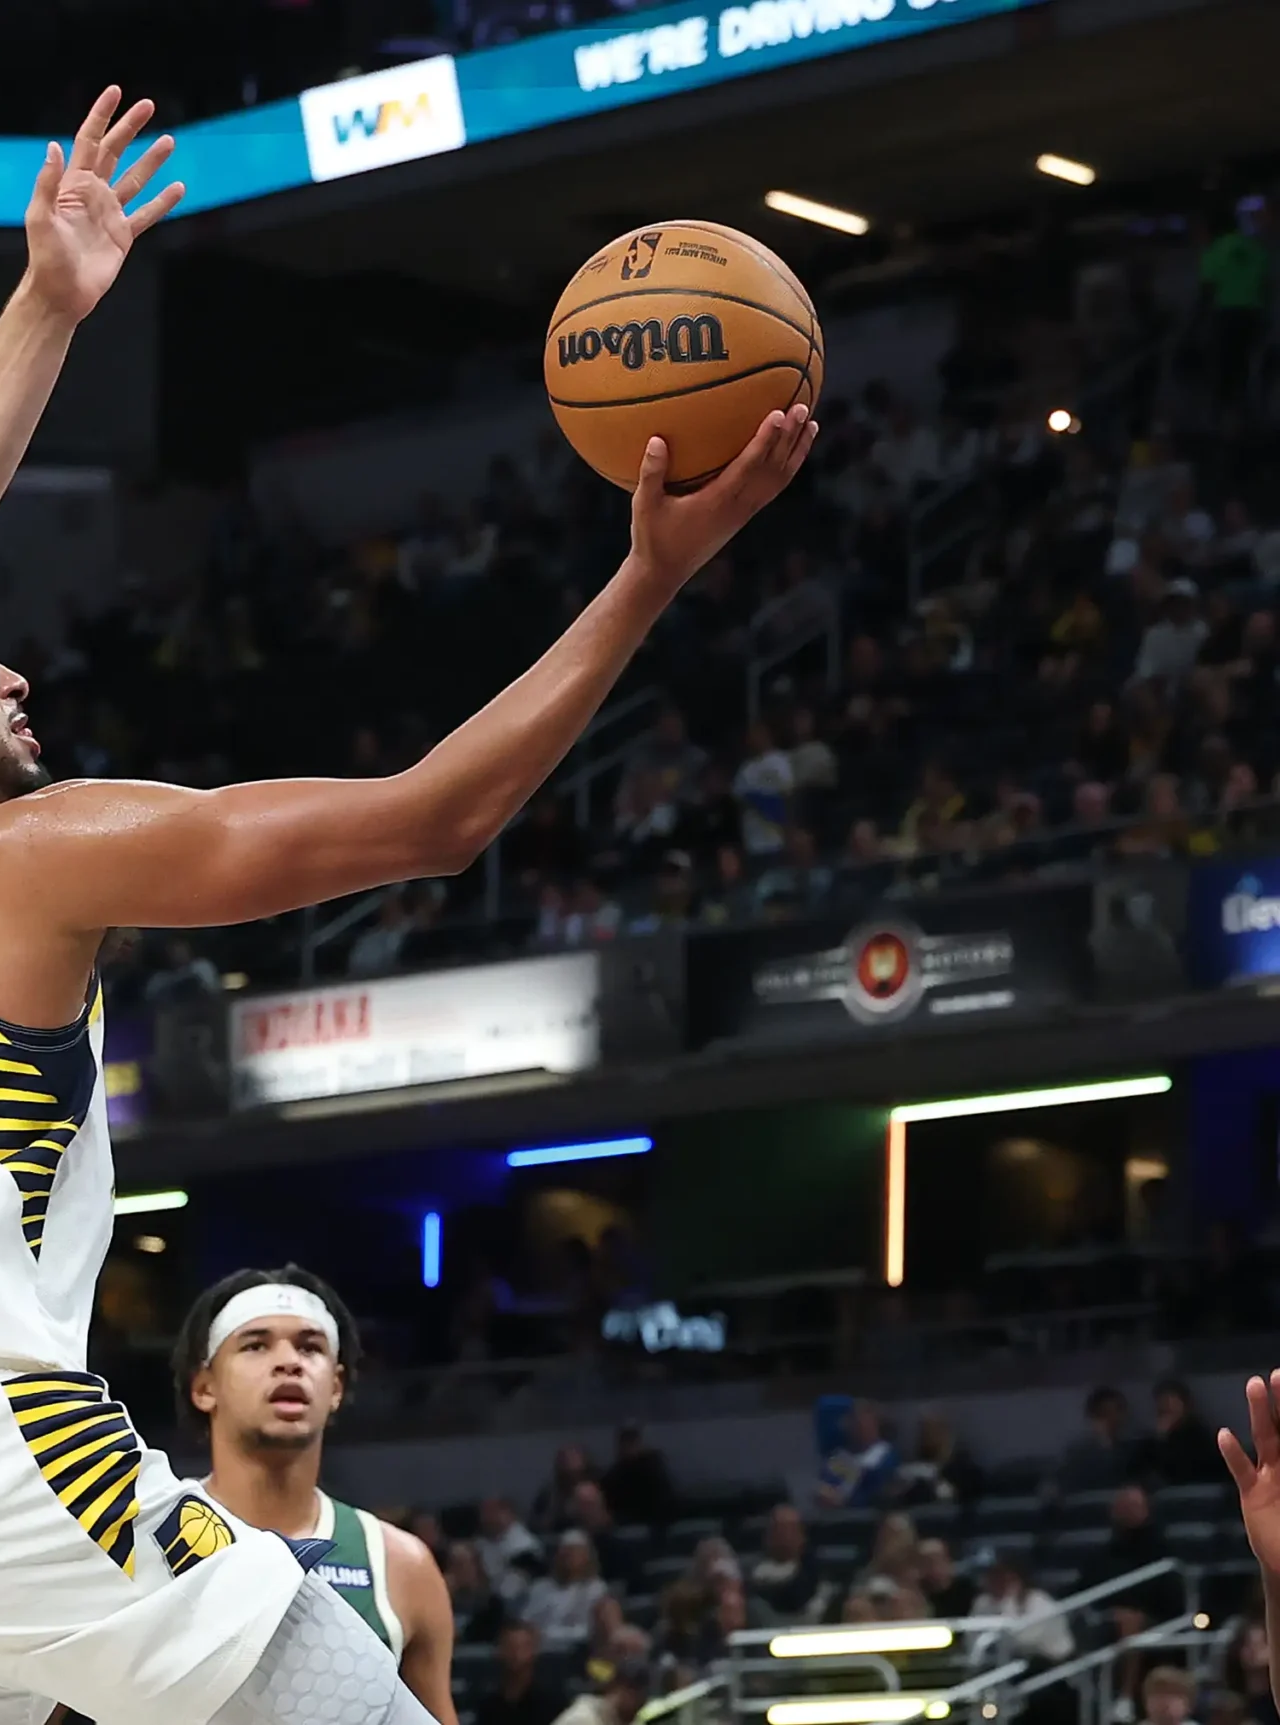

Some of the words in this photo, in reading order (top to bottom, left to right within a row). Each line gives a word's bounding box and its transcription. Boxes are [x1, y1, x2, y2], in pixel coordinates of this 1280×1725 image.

[574, 16, 709, 91] WE'RE
[332, 92, 433, 145] WM
[558, 313, 729, 372] Wilson
